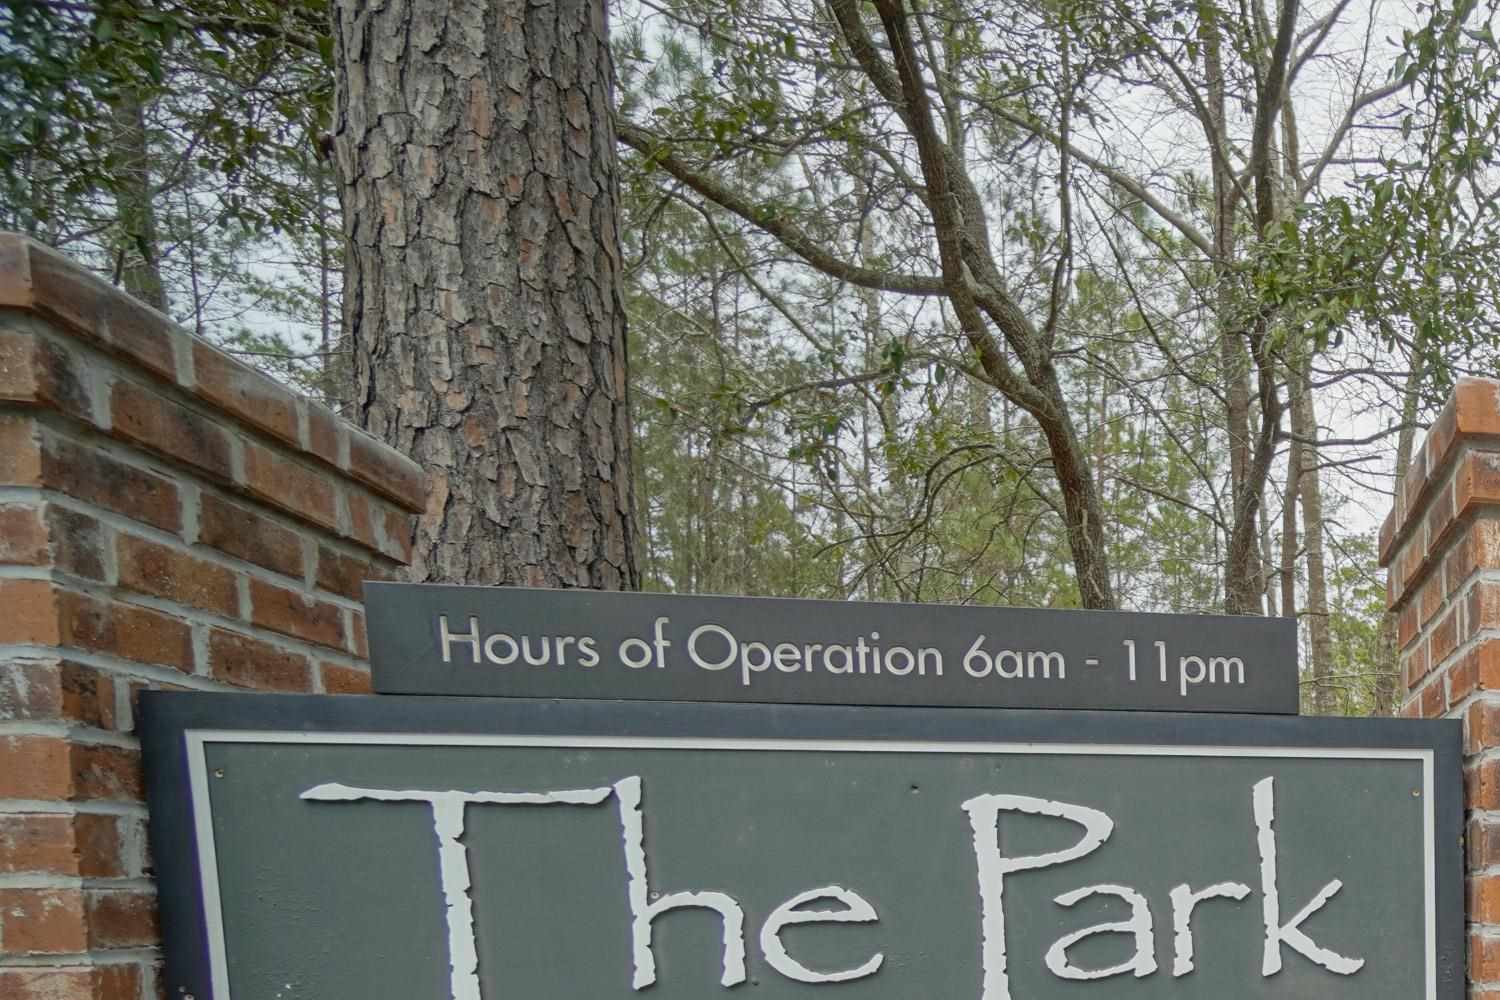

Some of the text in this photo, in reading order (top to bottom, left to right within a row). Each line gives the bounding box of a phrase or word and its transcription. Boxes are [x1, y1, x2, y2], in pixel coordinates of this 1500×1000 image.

[439, 616, 600, 668] Hours
[619, 617, 671, 669] of
[687, 624, 943, 688] Operation
[962, 635, 1066, 680] 6am
[1123, 639, 1246, 697] 11pm
